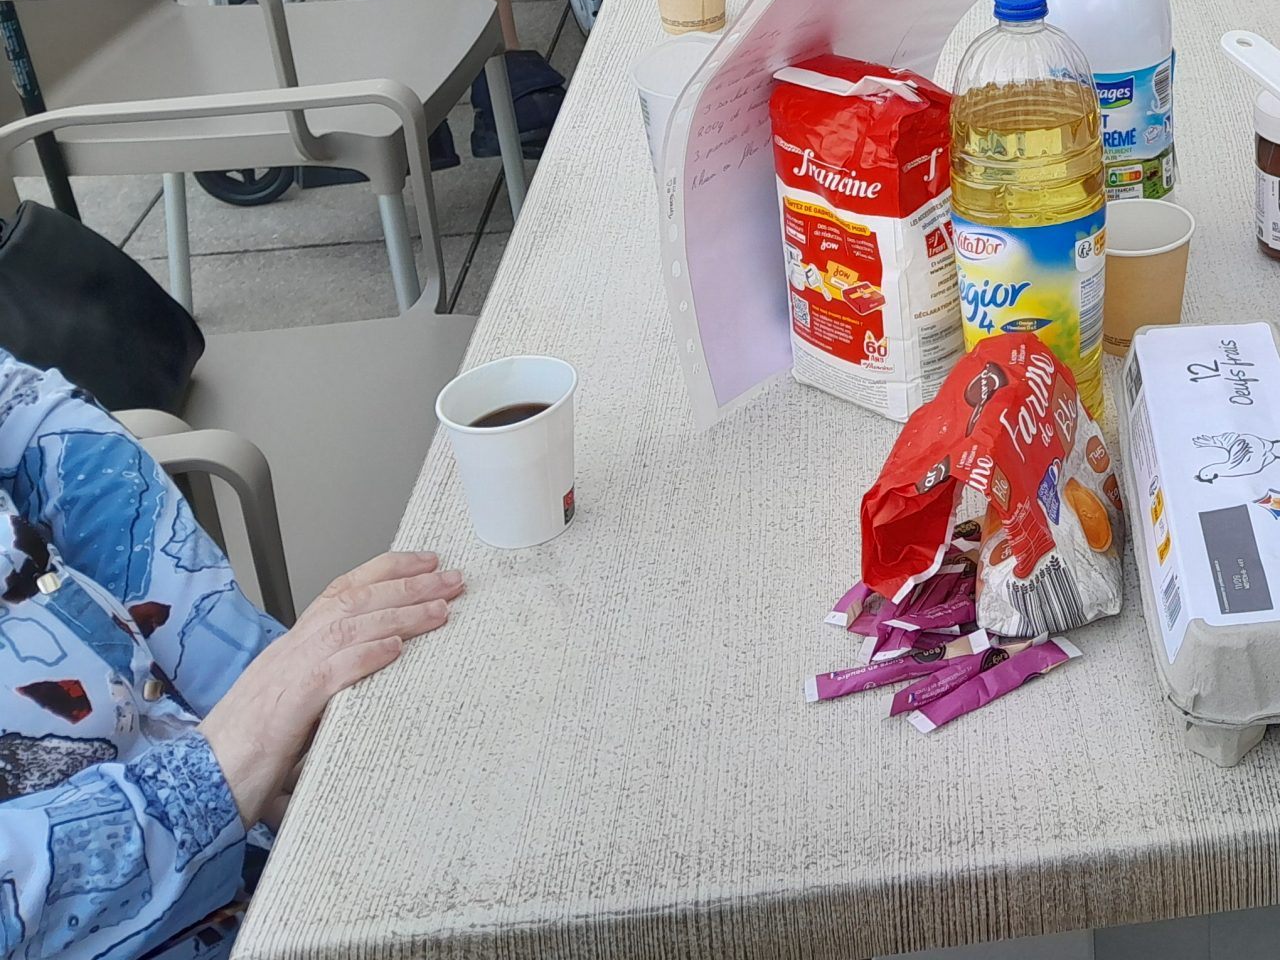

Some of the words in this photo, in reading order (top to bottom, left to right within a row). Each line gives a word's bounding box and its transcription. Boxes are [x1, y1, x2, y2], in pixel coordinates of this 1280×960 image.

[1097, 86, 1131, 102] ages
[978, 311, 995, 335] 4
[865, 341, 888, 358] 60
[1219, 339, 1255, 367] frais
[1186, 359, 1222, 384] 12
[1224, 366, 1260, 406] Oeufs
[1089, 444, 1106, 465] T45
[965, 454, 994, 495] ine
